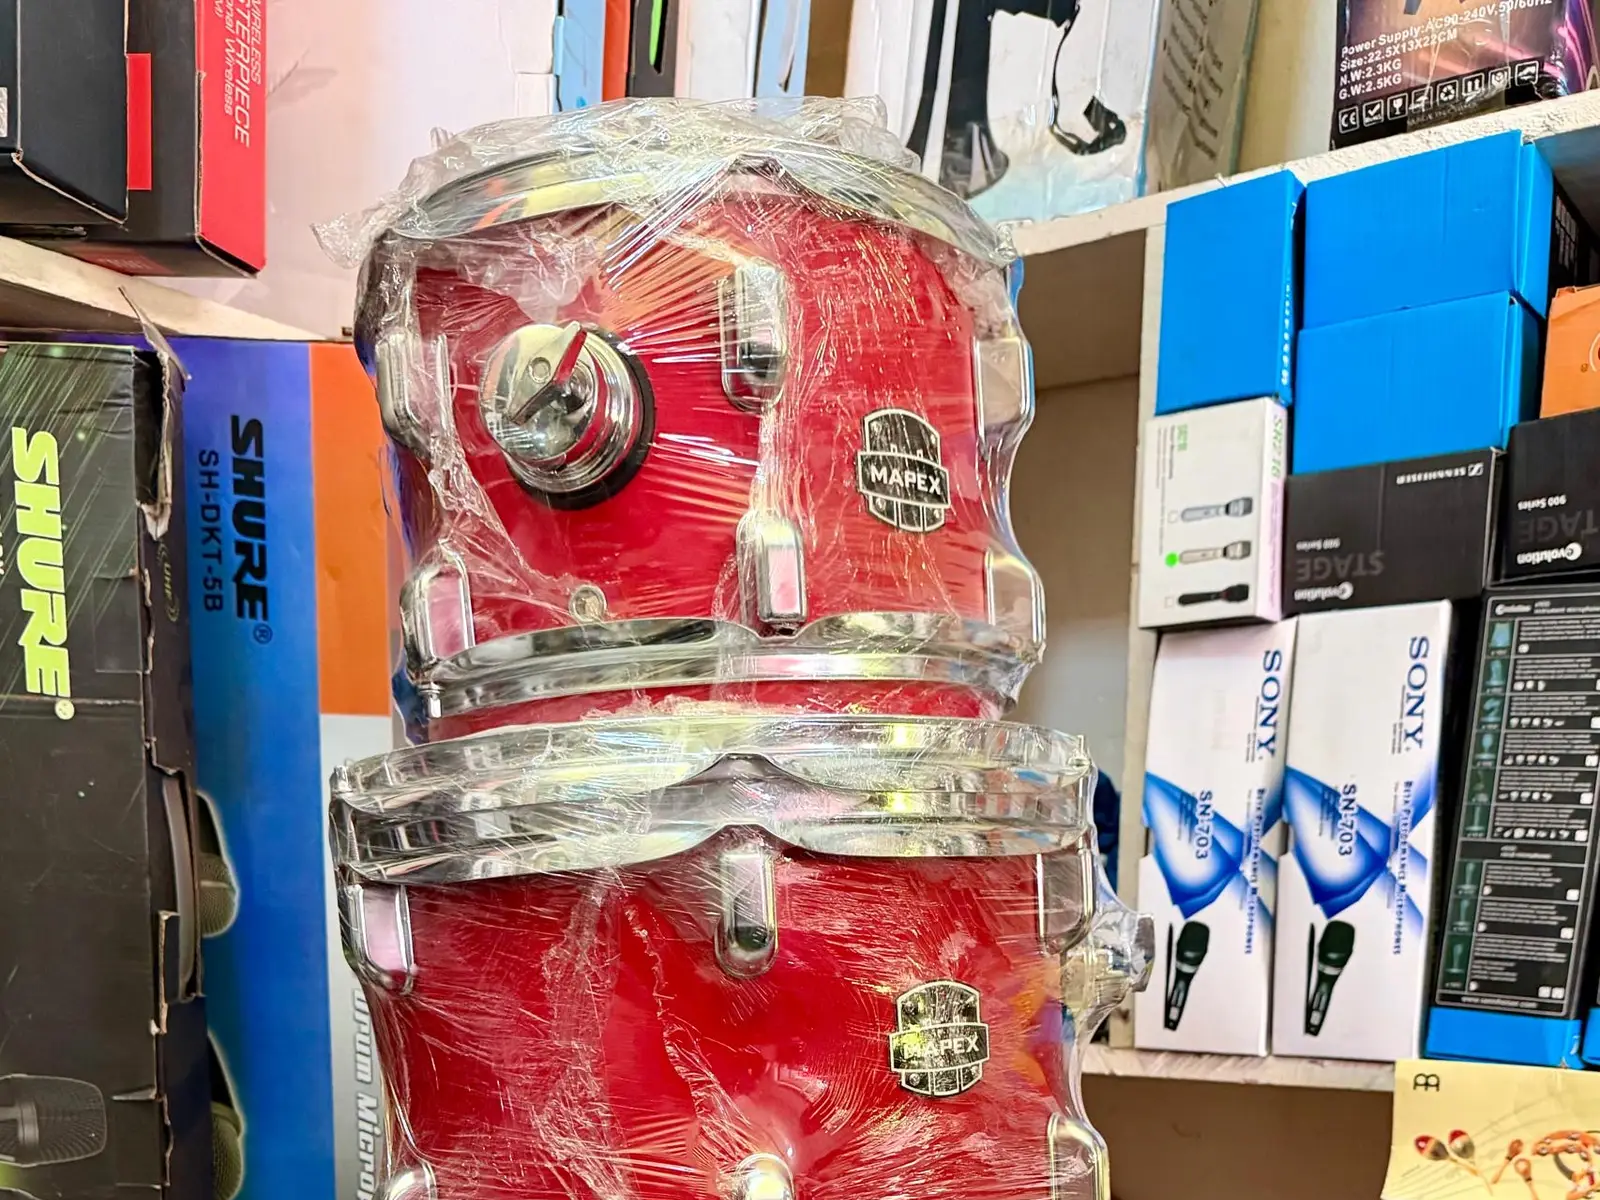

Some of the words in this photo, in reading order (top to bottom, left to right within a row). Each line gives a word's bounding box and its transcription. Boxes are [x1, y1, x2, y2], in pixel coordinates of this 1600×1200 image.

[1340, 29, 1458, 72] Size:22.5X13X22CM
[1341, 39, 1377, 56] Power
[224, 38, 236, 116] Wireless
[1339, 74, 1402, 100] G.W:2.5KG
[1340, 60, 1402, 86] N.W:2.3KG
[870, 463, 941, 496] MAPEX
[1517, 498, 1547, 511] Series
[1548, 494, 1567, 507] 900
[199, 449, 223, 613] SH-DKT-5B
[231, 414, 269, 622] SHURE
[11, 426, 71, 698] SHURE
[1296, 551, 1385, 583] STAGE
[1257, 650, 1283, 758] SONY
[1403, 636, 1430, 750] SONY
[903, 1032, 980, 1060] MAPEX
